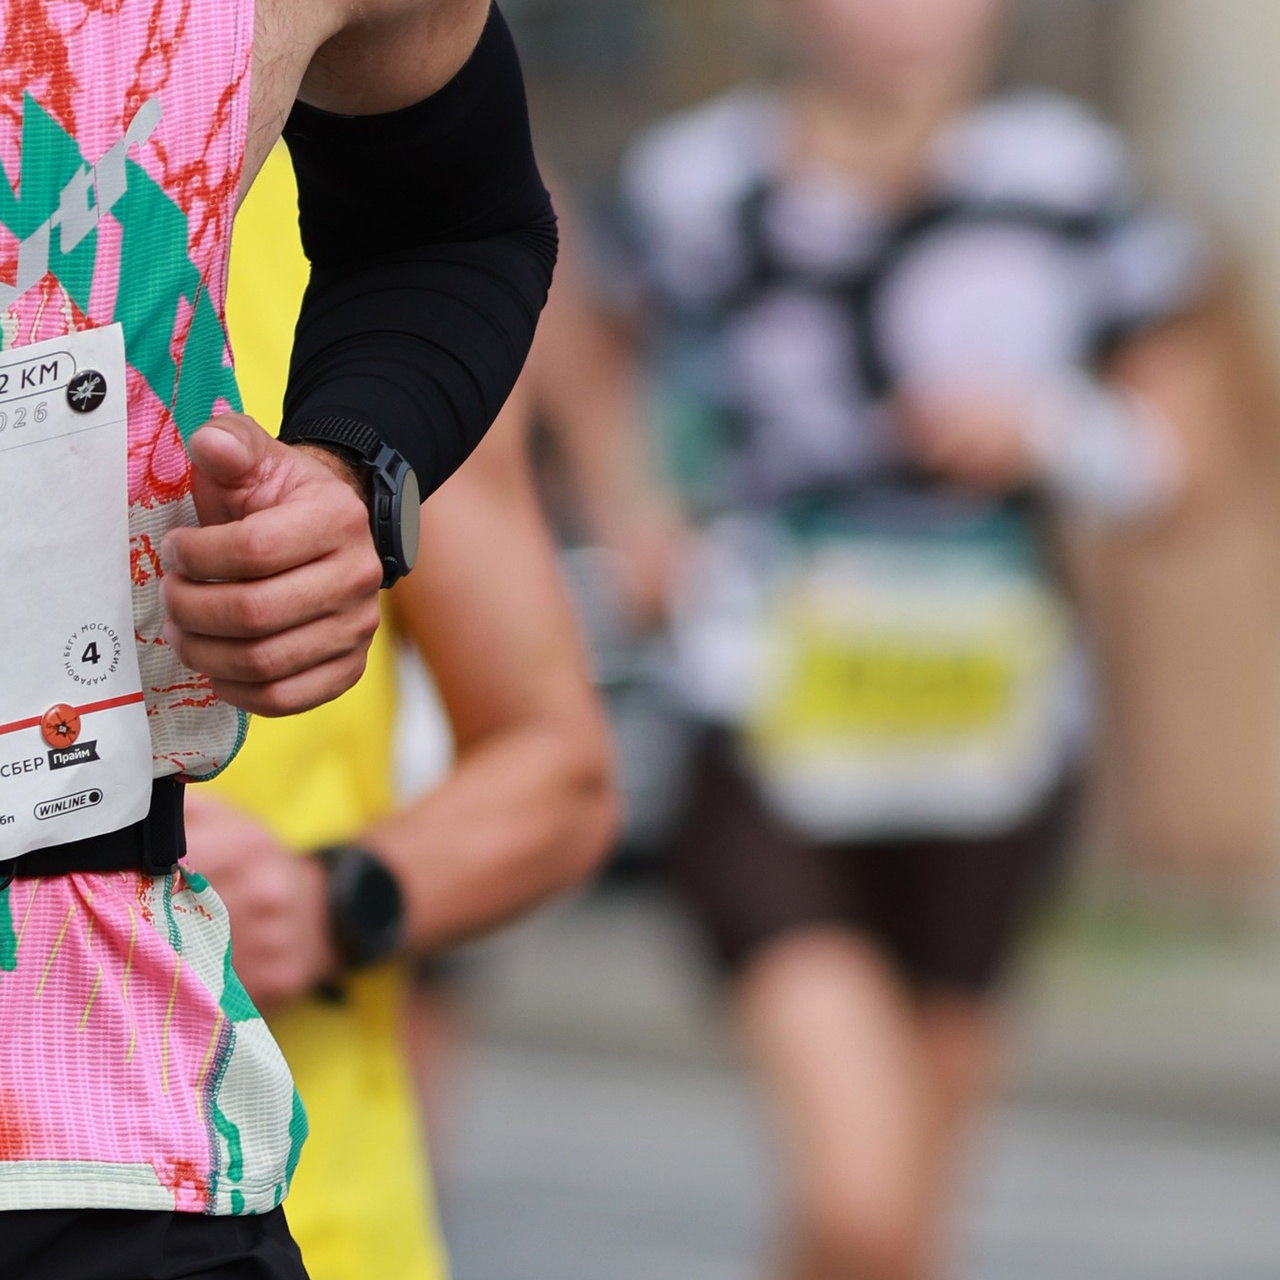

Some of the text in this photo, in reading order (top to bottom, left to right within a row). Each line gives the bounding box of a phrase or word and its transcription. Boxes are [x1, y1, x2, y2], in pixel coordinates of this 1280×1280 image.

[81, 641, 101, 665] 4
[0, 747, 91, 778] СБЕР Прайм
[39, 794, 87, 817] WINLINE
